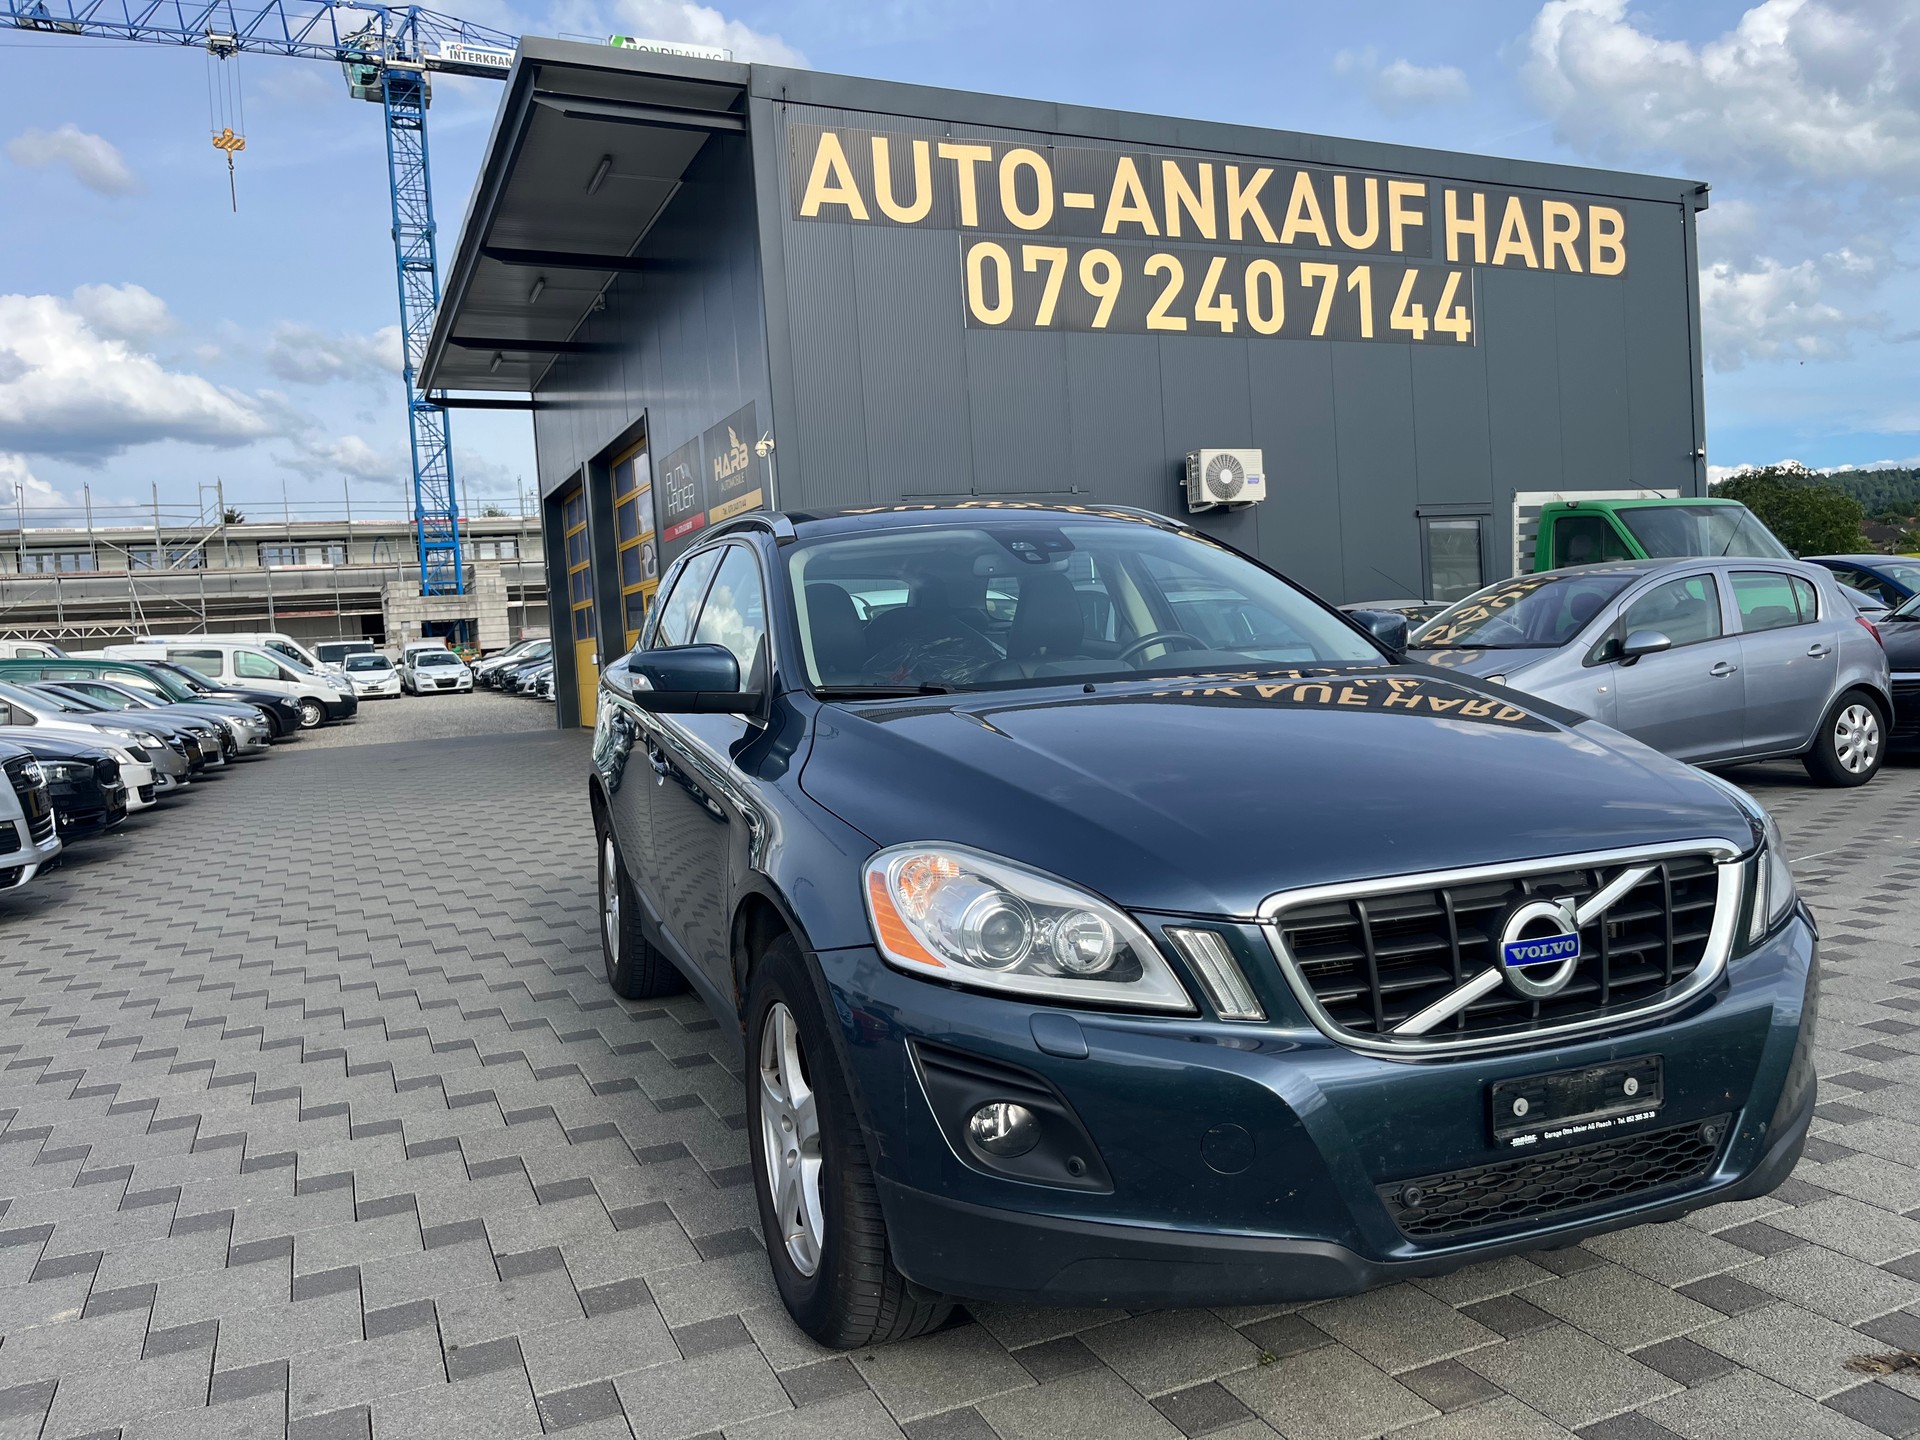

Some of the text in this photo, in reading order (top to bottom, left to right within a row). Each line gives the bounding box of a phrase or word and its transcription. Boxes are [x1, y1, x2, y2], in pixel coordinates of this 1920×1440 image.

[449, 49, 512, 66] INTERKRAN
[801, 132, 1626, 276] AUTO-ANKAUF HARB
[967, 241, 1472, 342] 079 240 71 44
[713, 442, 749, 481] HARB
[1509, 939, 1576, 960] VOLVO
[1544, 1130, 1562, 1139] Garage
